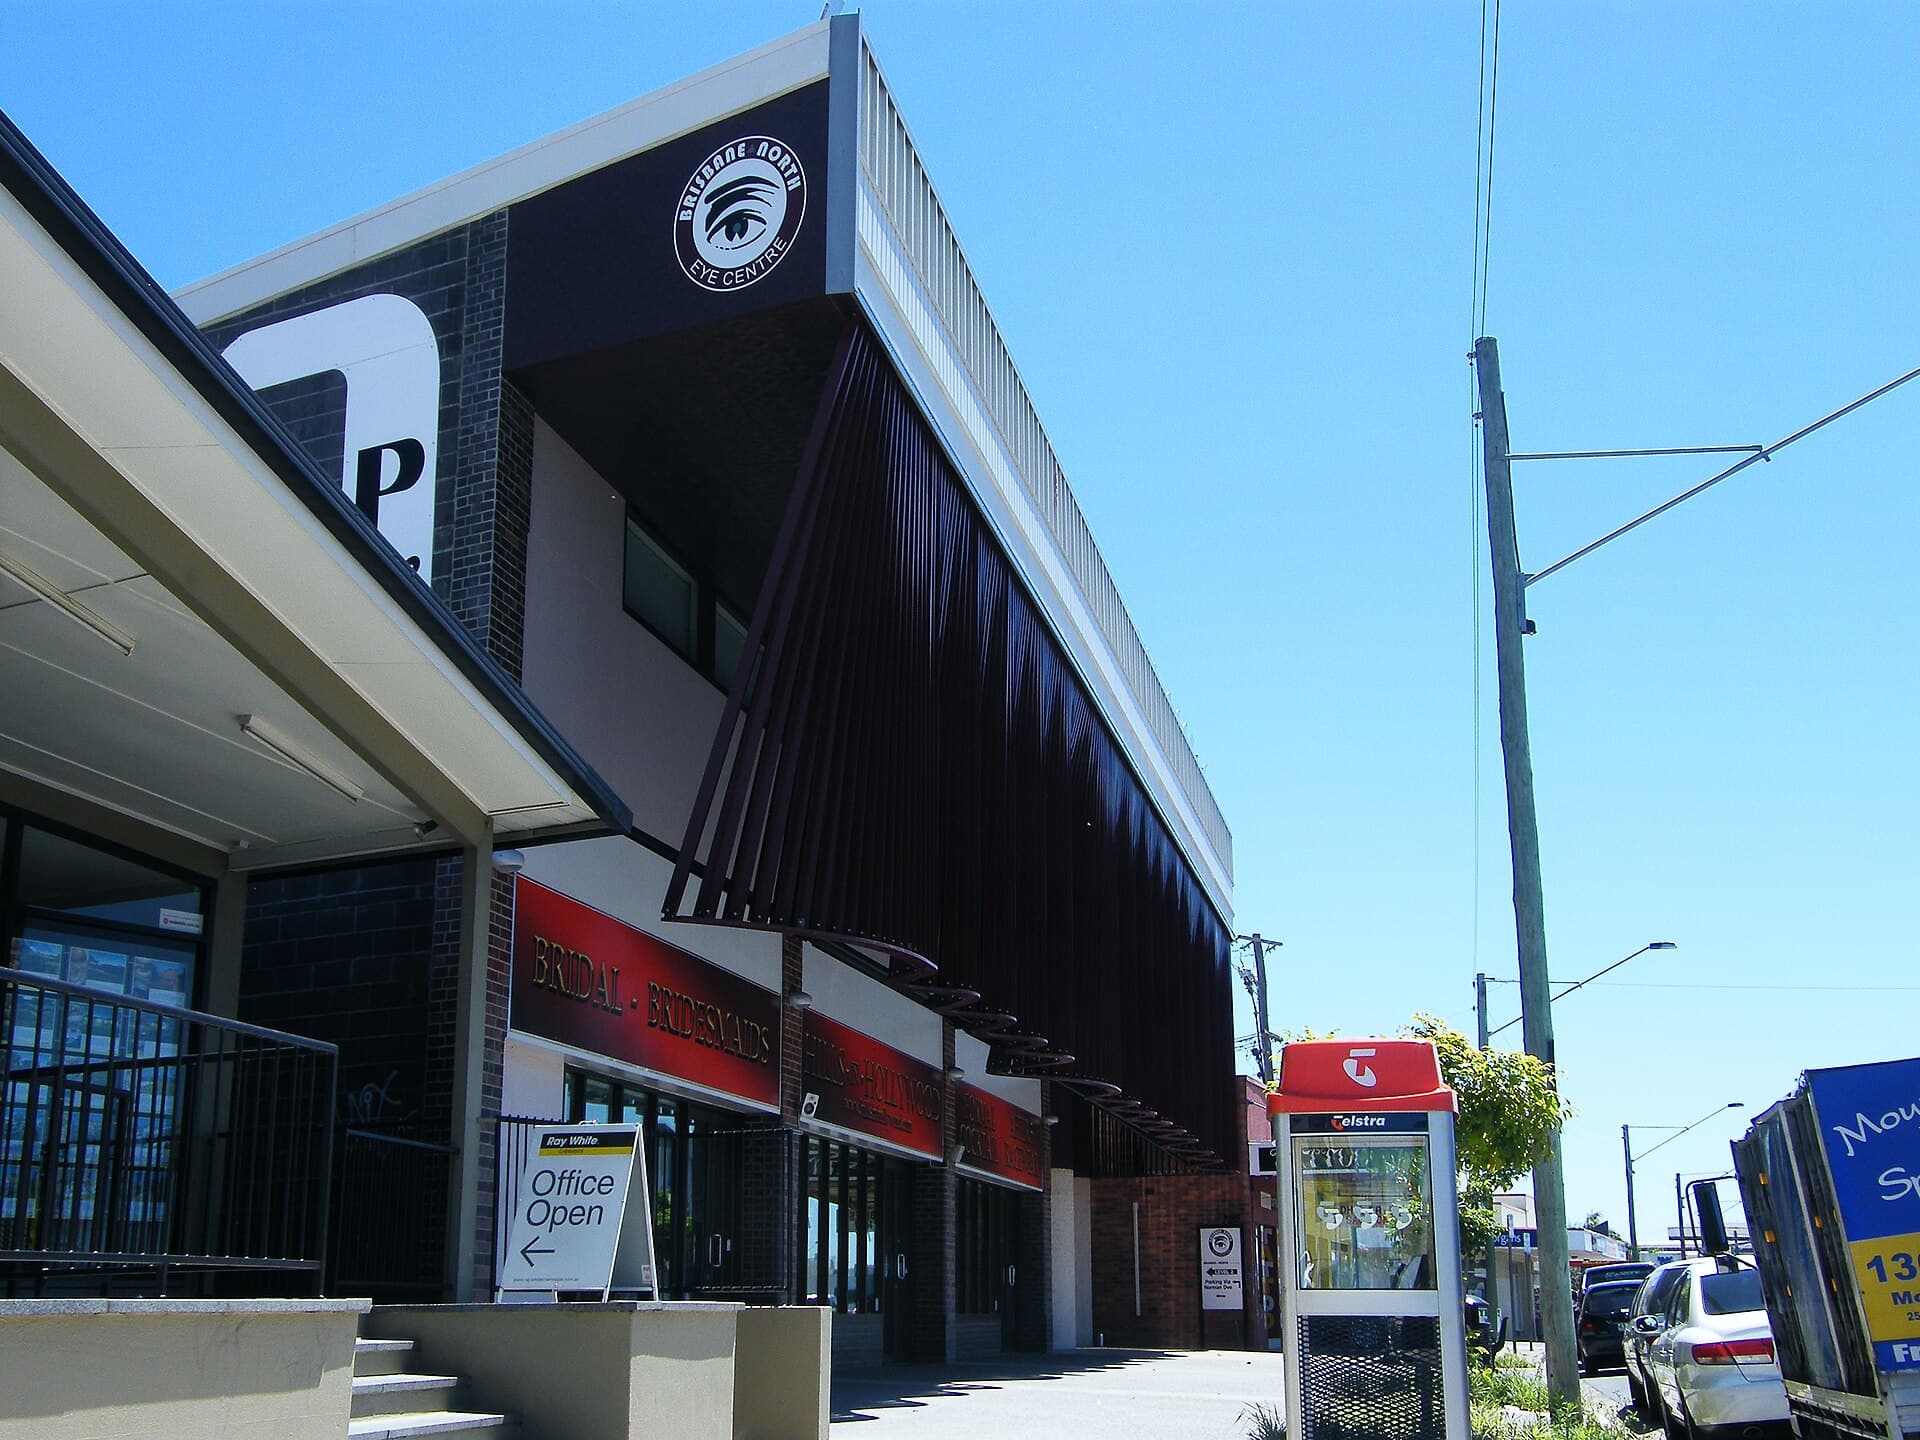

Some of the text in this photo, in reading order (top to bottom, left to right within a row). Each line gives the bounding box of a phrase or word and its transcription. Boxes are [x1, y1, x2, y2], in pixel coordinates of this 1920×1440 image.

[680, 141, 801, 222] BRISBANE NORTH
[690, 236, 788, 286] EYE CENTRE
[533, 935, 770, 1065] BRIDAL BRIDESMAIDS
[861, 1057, 941, 1121] HOLLYWOOD
[1331, 1115, 1385, 1131] Telstra
[546, 1136, 568, 1148] Ray
[532, 1169, 615, 1196] Office
[527, 1199, 603, 1232] Open
[1866, 1252, 1920, 1283] 13
